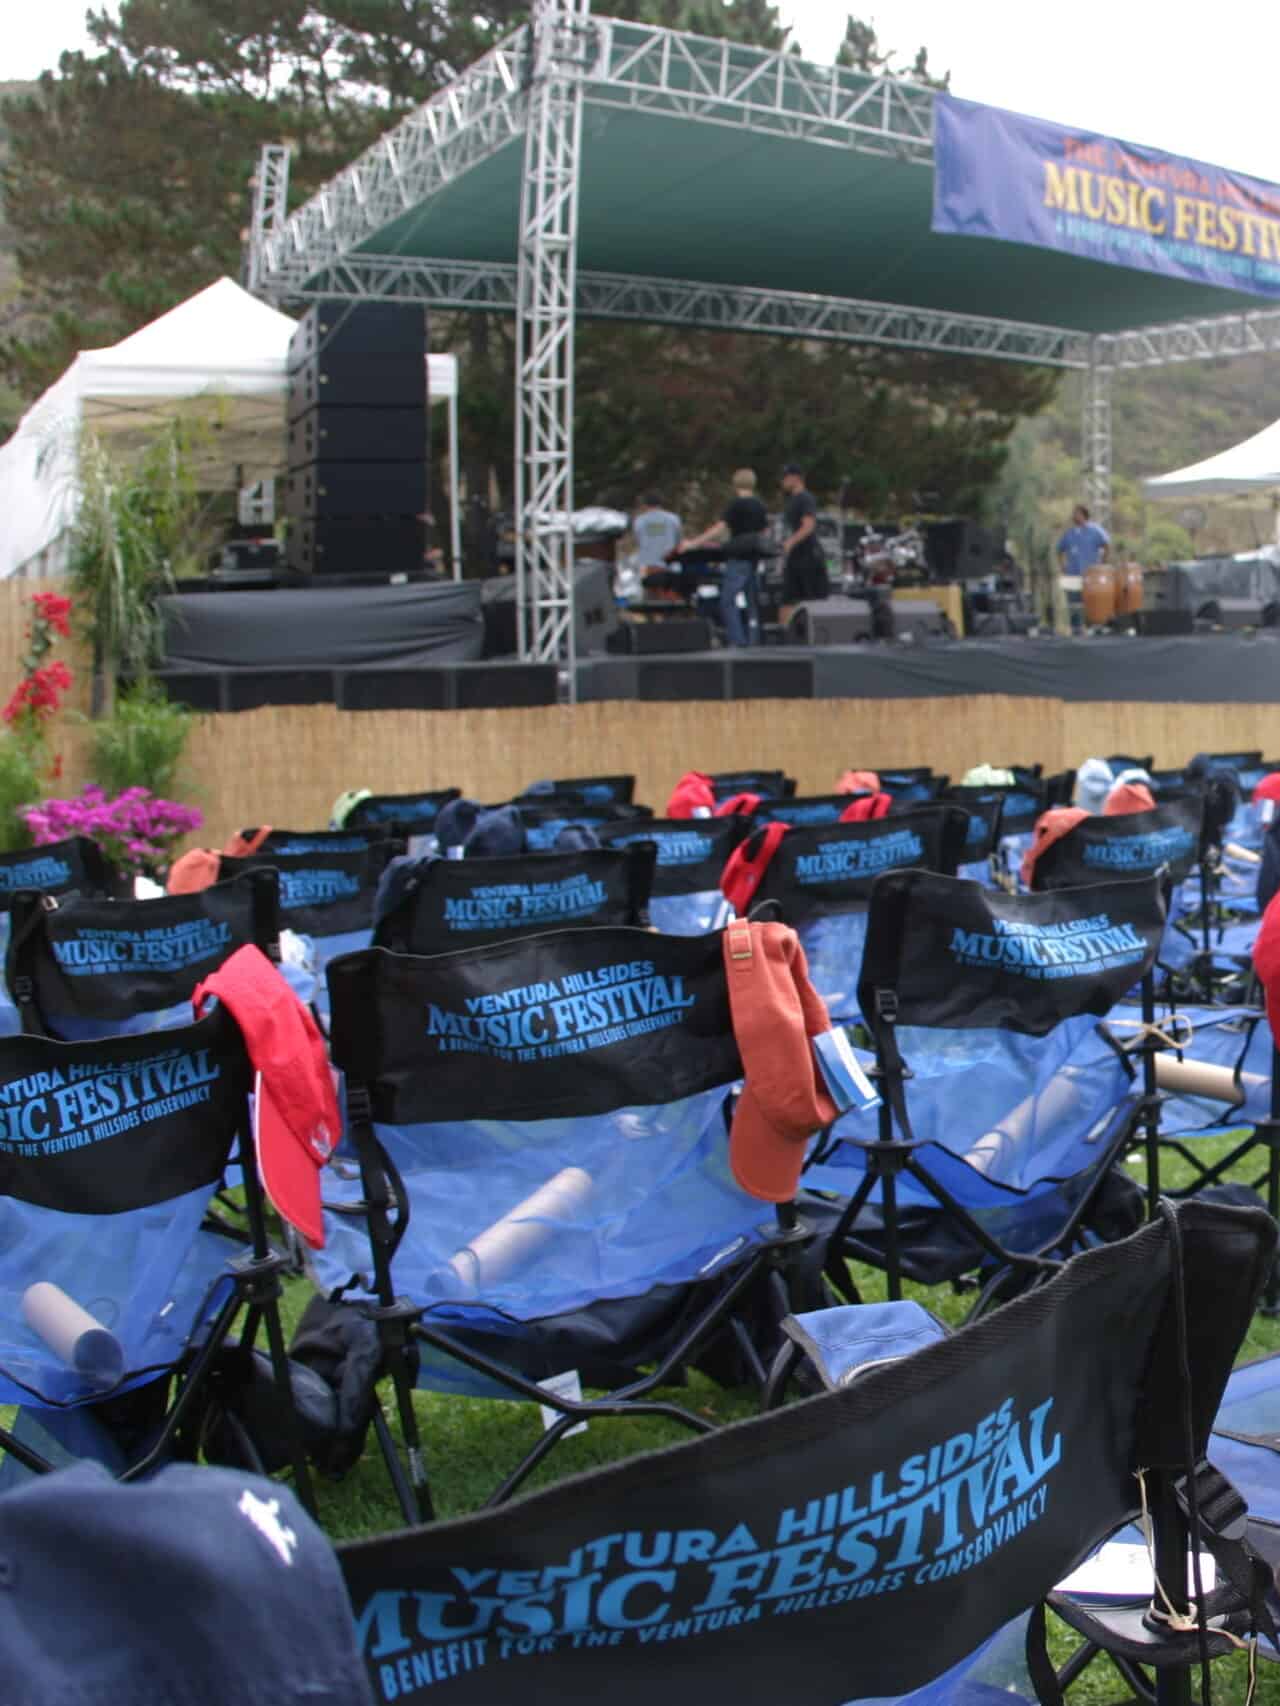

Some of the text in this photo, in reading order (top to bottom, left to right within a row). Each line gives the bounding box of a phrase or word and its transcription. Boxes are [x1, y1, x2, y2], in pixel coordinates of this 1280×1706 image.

[1042, 160, 1167, 236] MUSIC
[796, 851, 858, 877] MUSIC
[858, 834, 924, 869] FESTIVAL
[443, 895, 516, 922] MUSIC
[519, 879, 610, 919] FESTIVAL
[52, 937, 129, 966] MUSIC
[131, 921, 233, 963] FESTIVAL
[949, 927, 1048, 967] MUSIC
[1045, 922, 1148, 964] FESTIVAL
[425, 975, 696, 1048] MUSIC FESTIVAL
[464, 960, 655, 1015] VENTURA HILLSIDES
[0, 1066, 66, 1106] NTURA
[41, 1128, 92, 1156] VENTURA
[92, 1114, 141, 1141] HILLSIDES
[141, 1084, 212, 1123] CONSERVANCY
[53, 1049, 221, 1134] FESTIVAL
[692, 1395, 1062, 1613] FESTIVAL
[776, 1397, 1016, 1545] HILLSIDES
[379, 1638, 488, 1702] BENEFIT
[571, 1630, 624, 1649] THE
[638, 1600, 760, 1644] VENTURA
[774, 1570, 905, 1616] HILLSIDES
[914, 1482, 1048, 1586] CONSERVANCY
